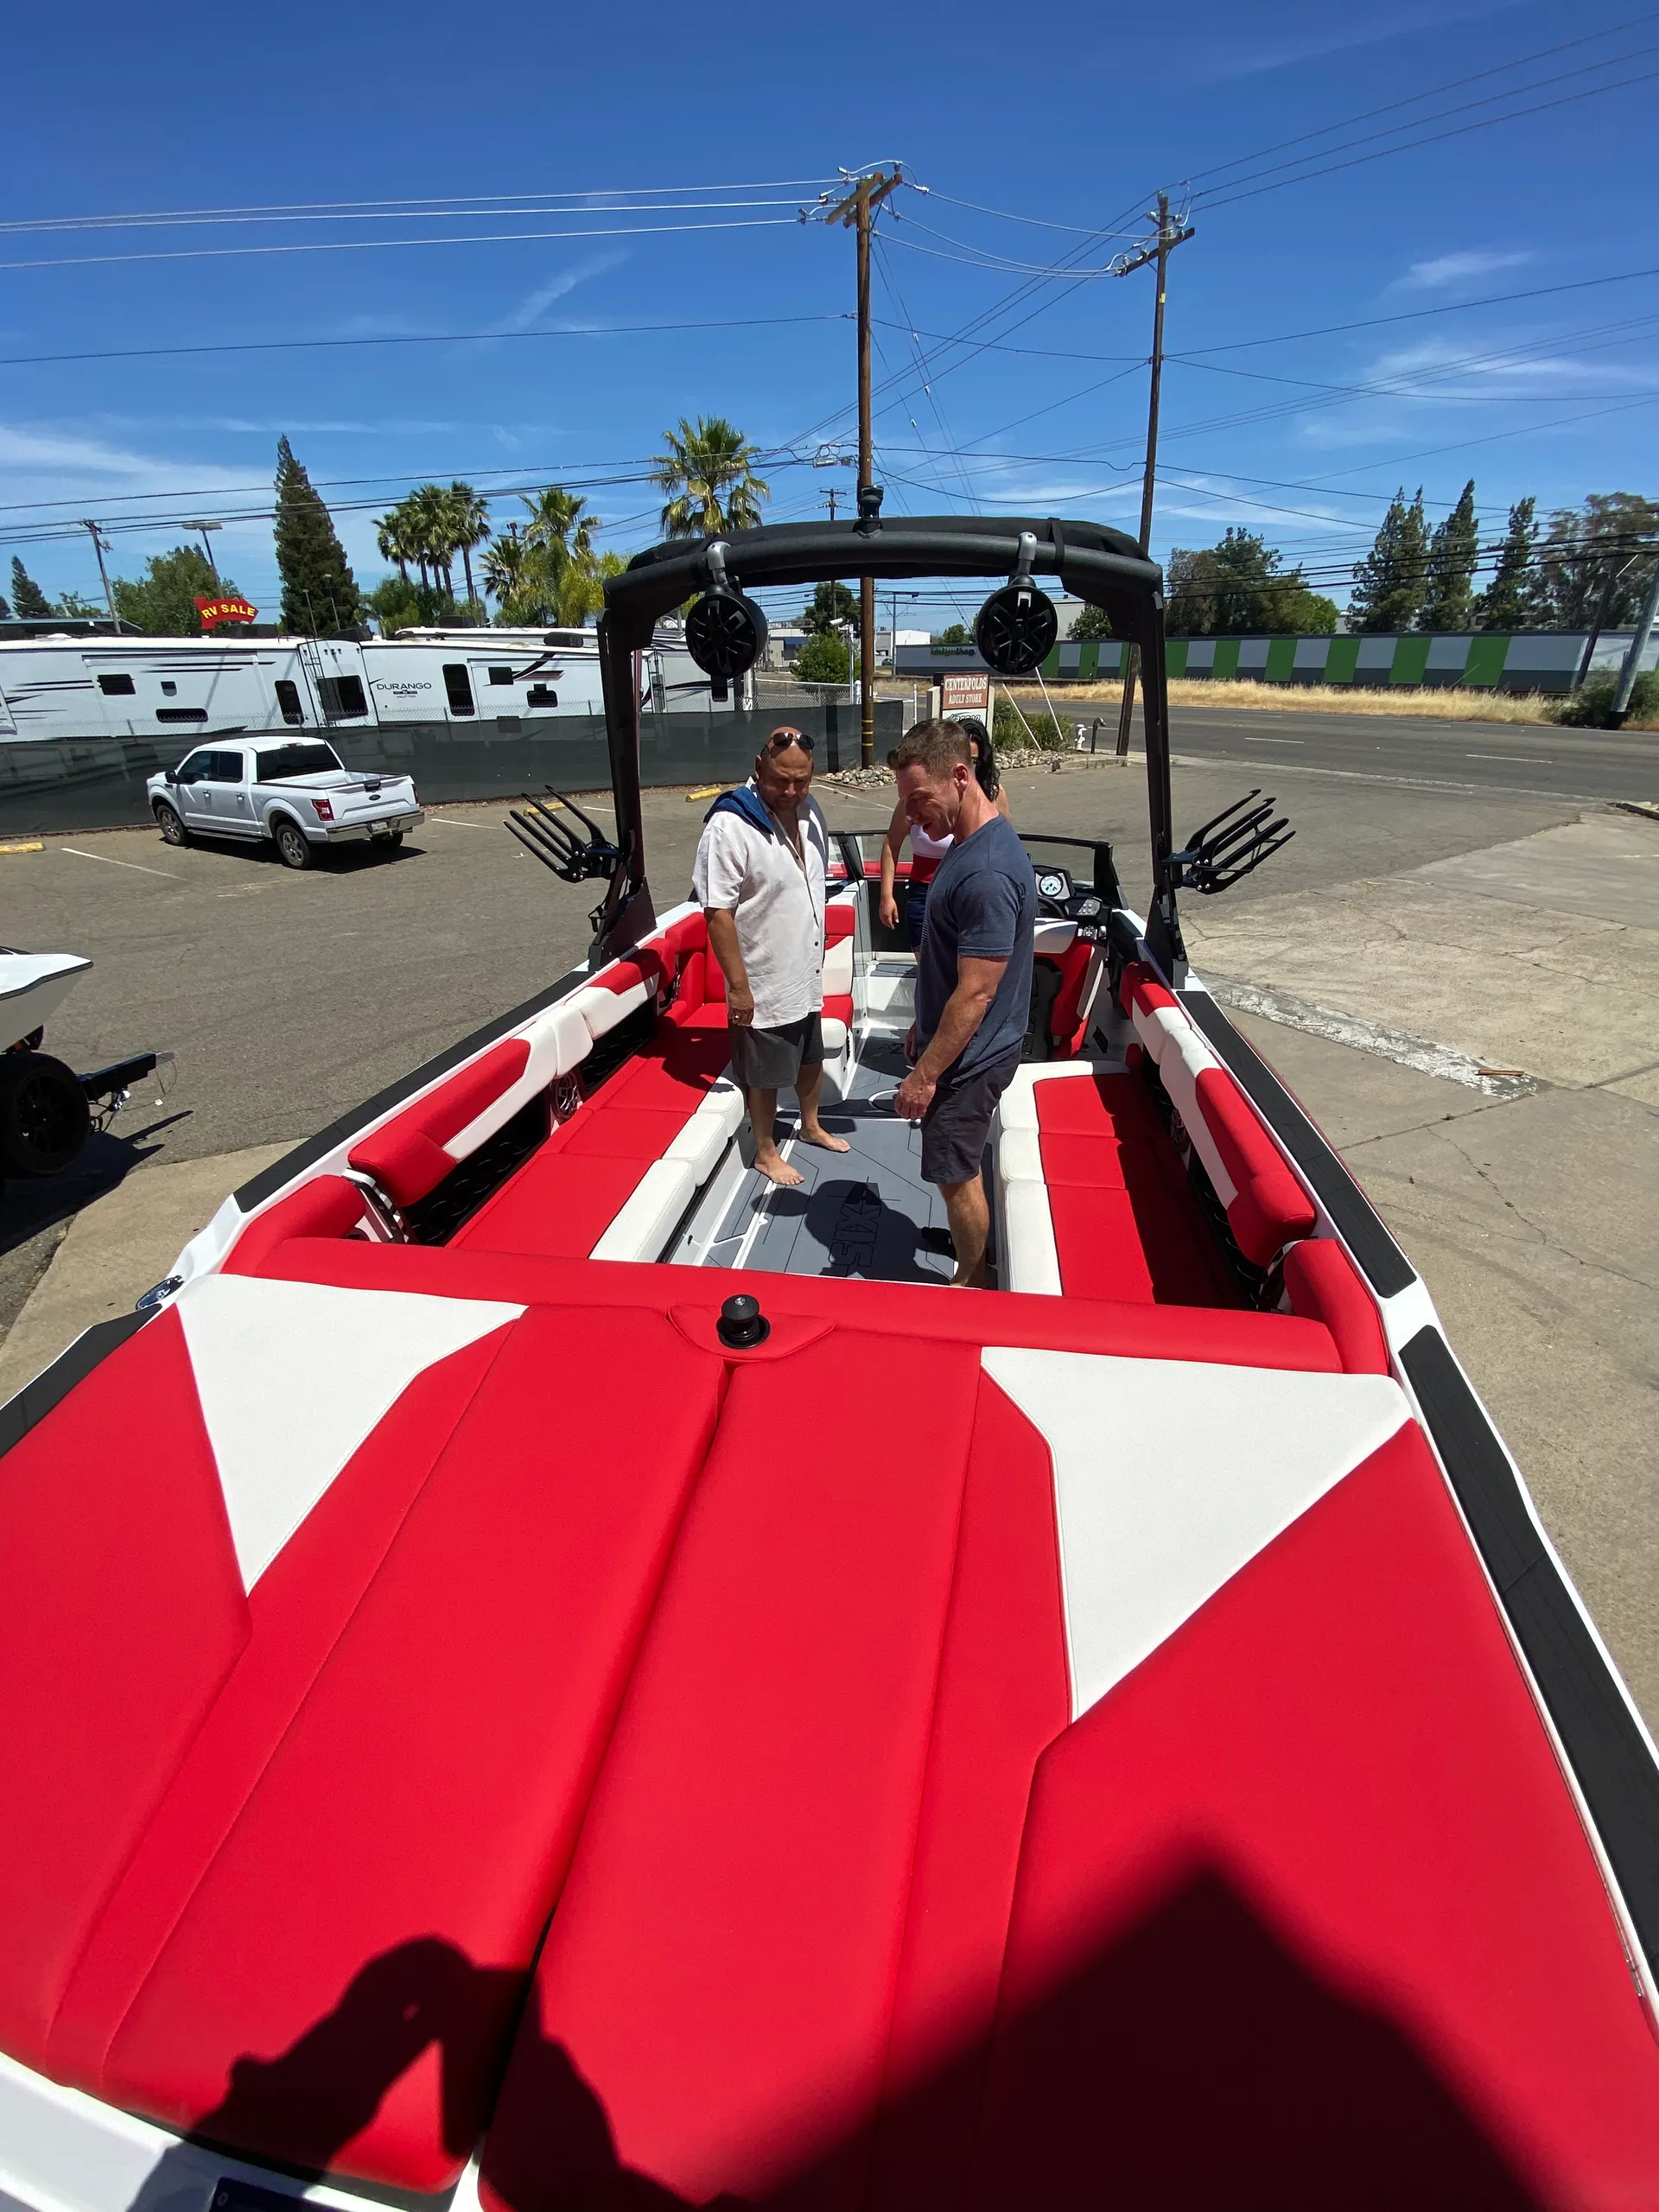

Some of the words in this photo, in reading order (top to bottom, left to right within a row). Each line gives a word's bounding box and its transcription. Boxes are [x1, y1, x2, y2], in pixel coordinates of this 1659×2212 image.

[201, 607, 218, 619] RV
[220, 604, 256, 617] SALE
[944, 677, 987, 691] CENTERFOLDS
[949, 694, 965, 704] ADULT
[965, 693, 982, 703] STORE
[829, 1182, 881, 1268] AXIS
